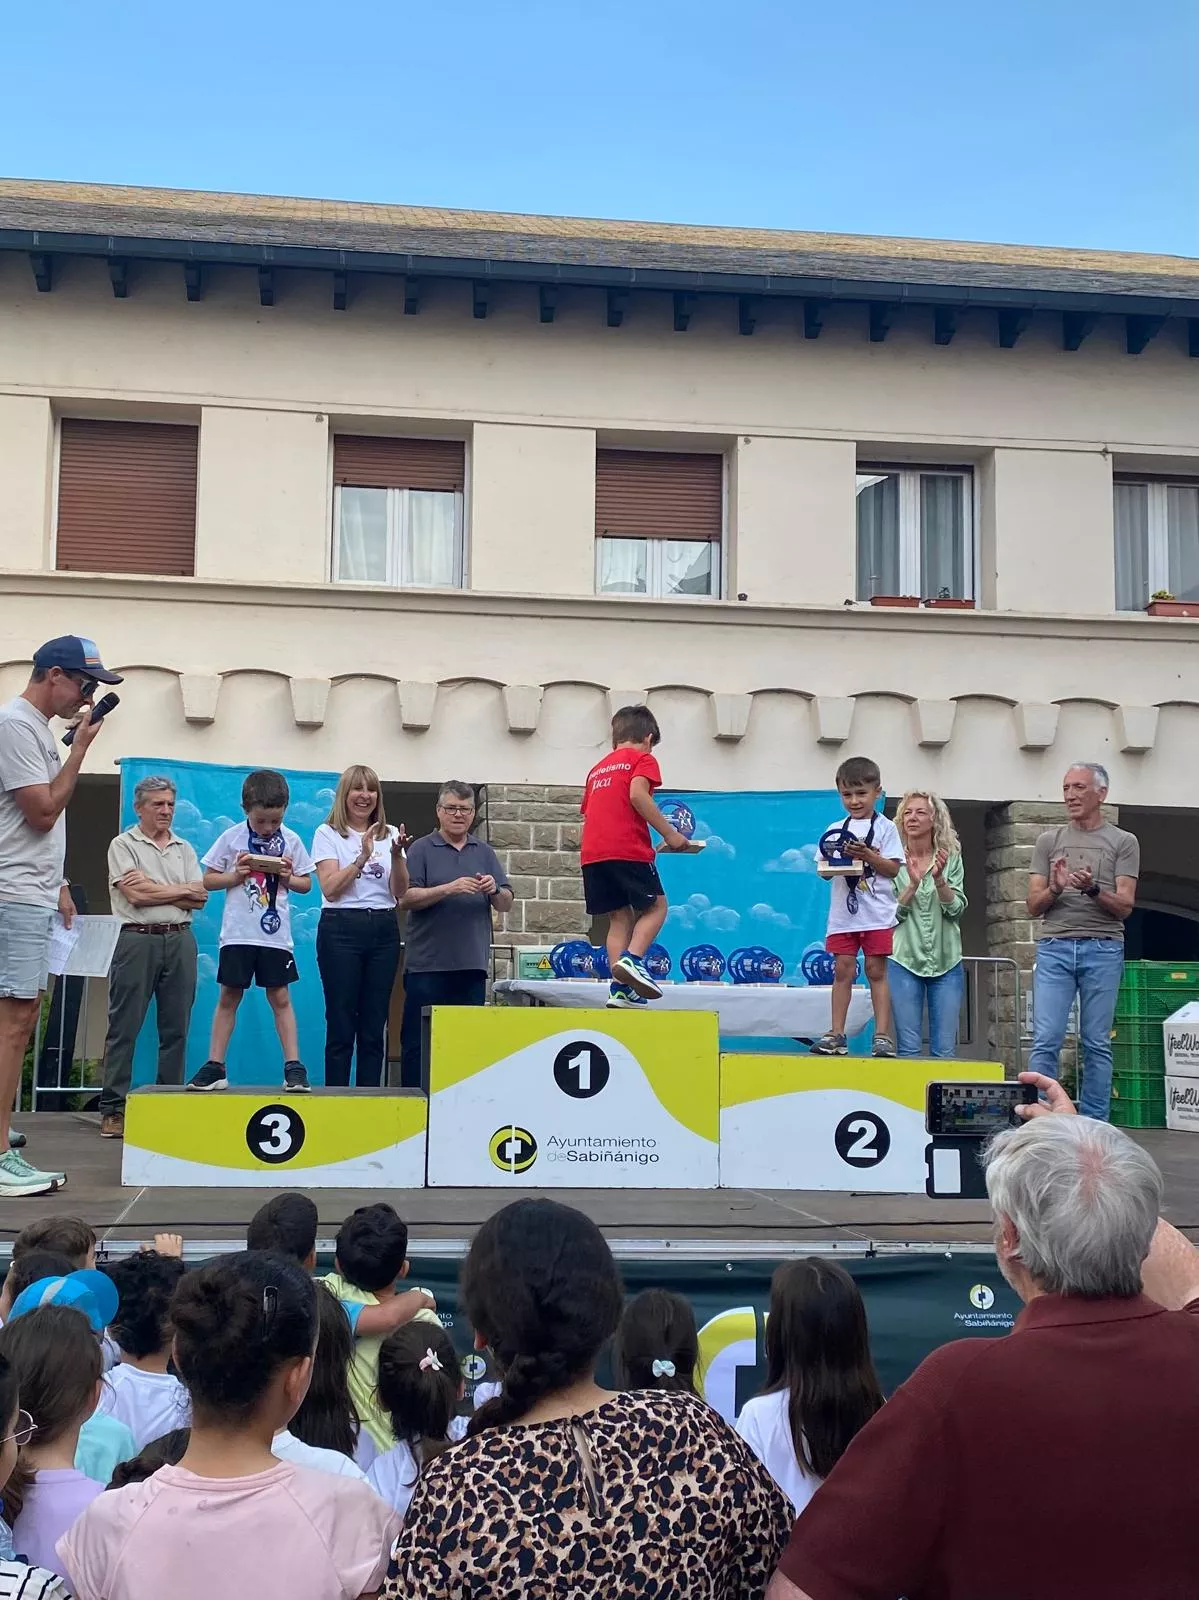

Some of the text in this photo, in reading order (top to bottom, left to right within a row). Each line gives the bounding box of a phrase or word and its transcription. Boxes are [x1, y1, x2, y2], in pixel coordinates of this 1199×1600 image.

[568, 1050, 591, 1090] 1
[258, 1113, 292, 1155] 3
[546, 1135, 657, 1149] Ayuntamiento
[847, 1119, 878, 1158] 2
[953, 1312, 1013, 1321] Ayuntamiento
